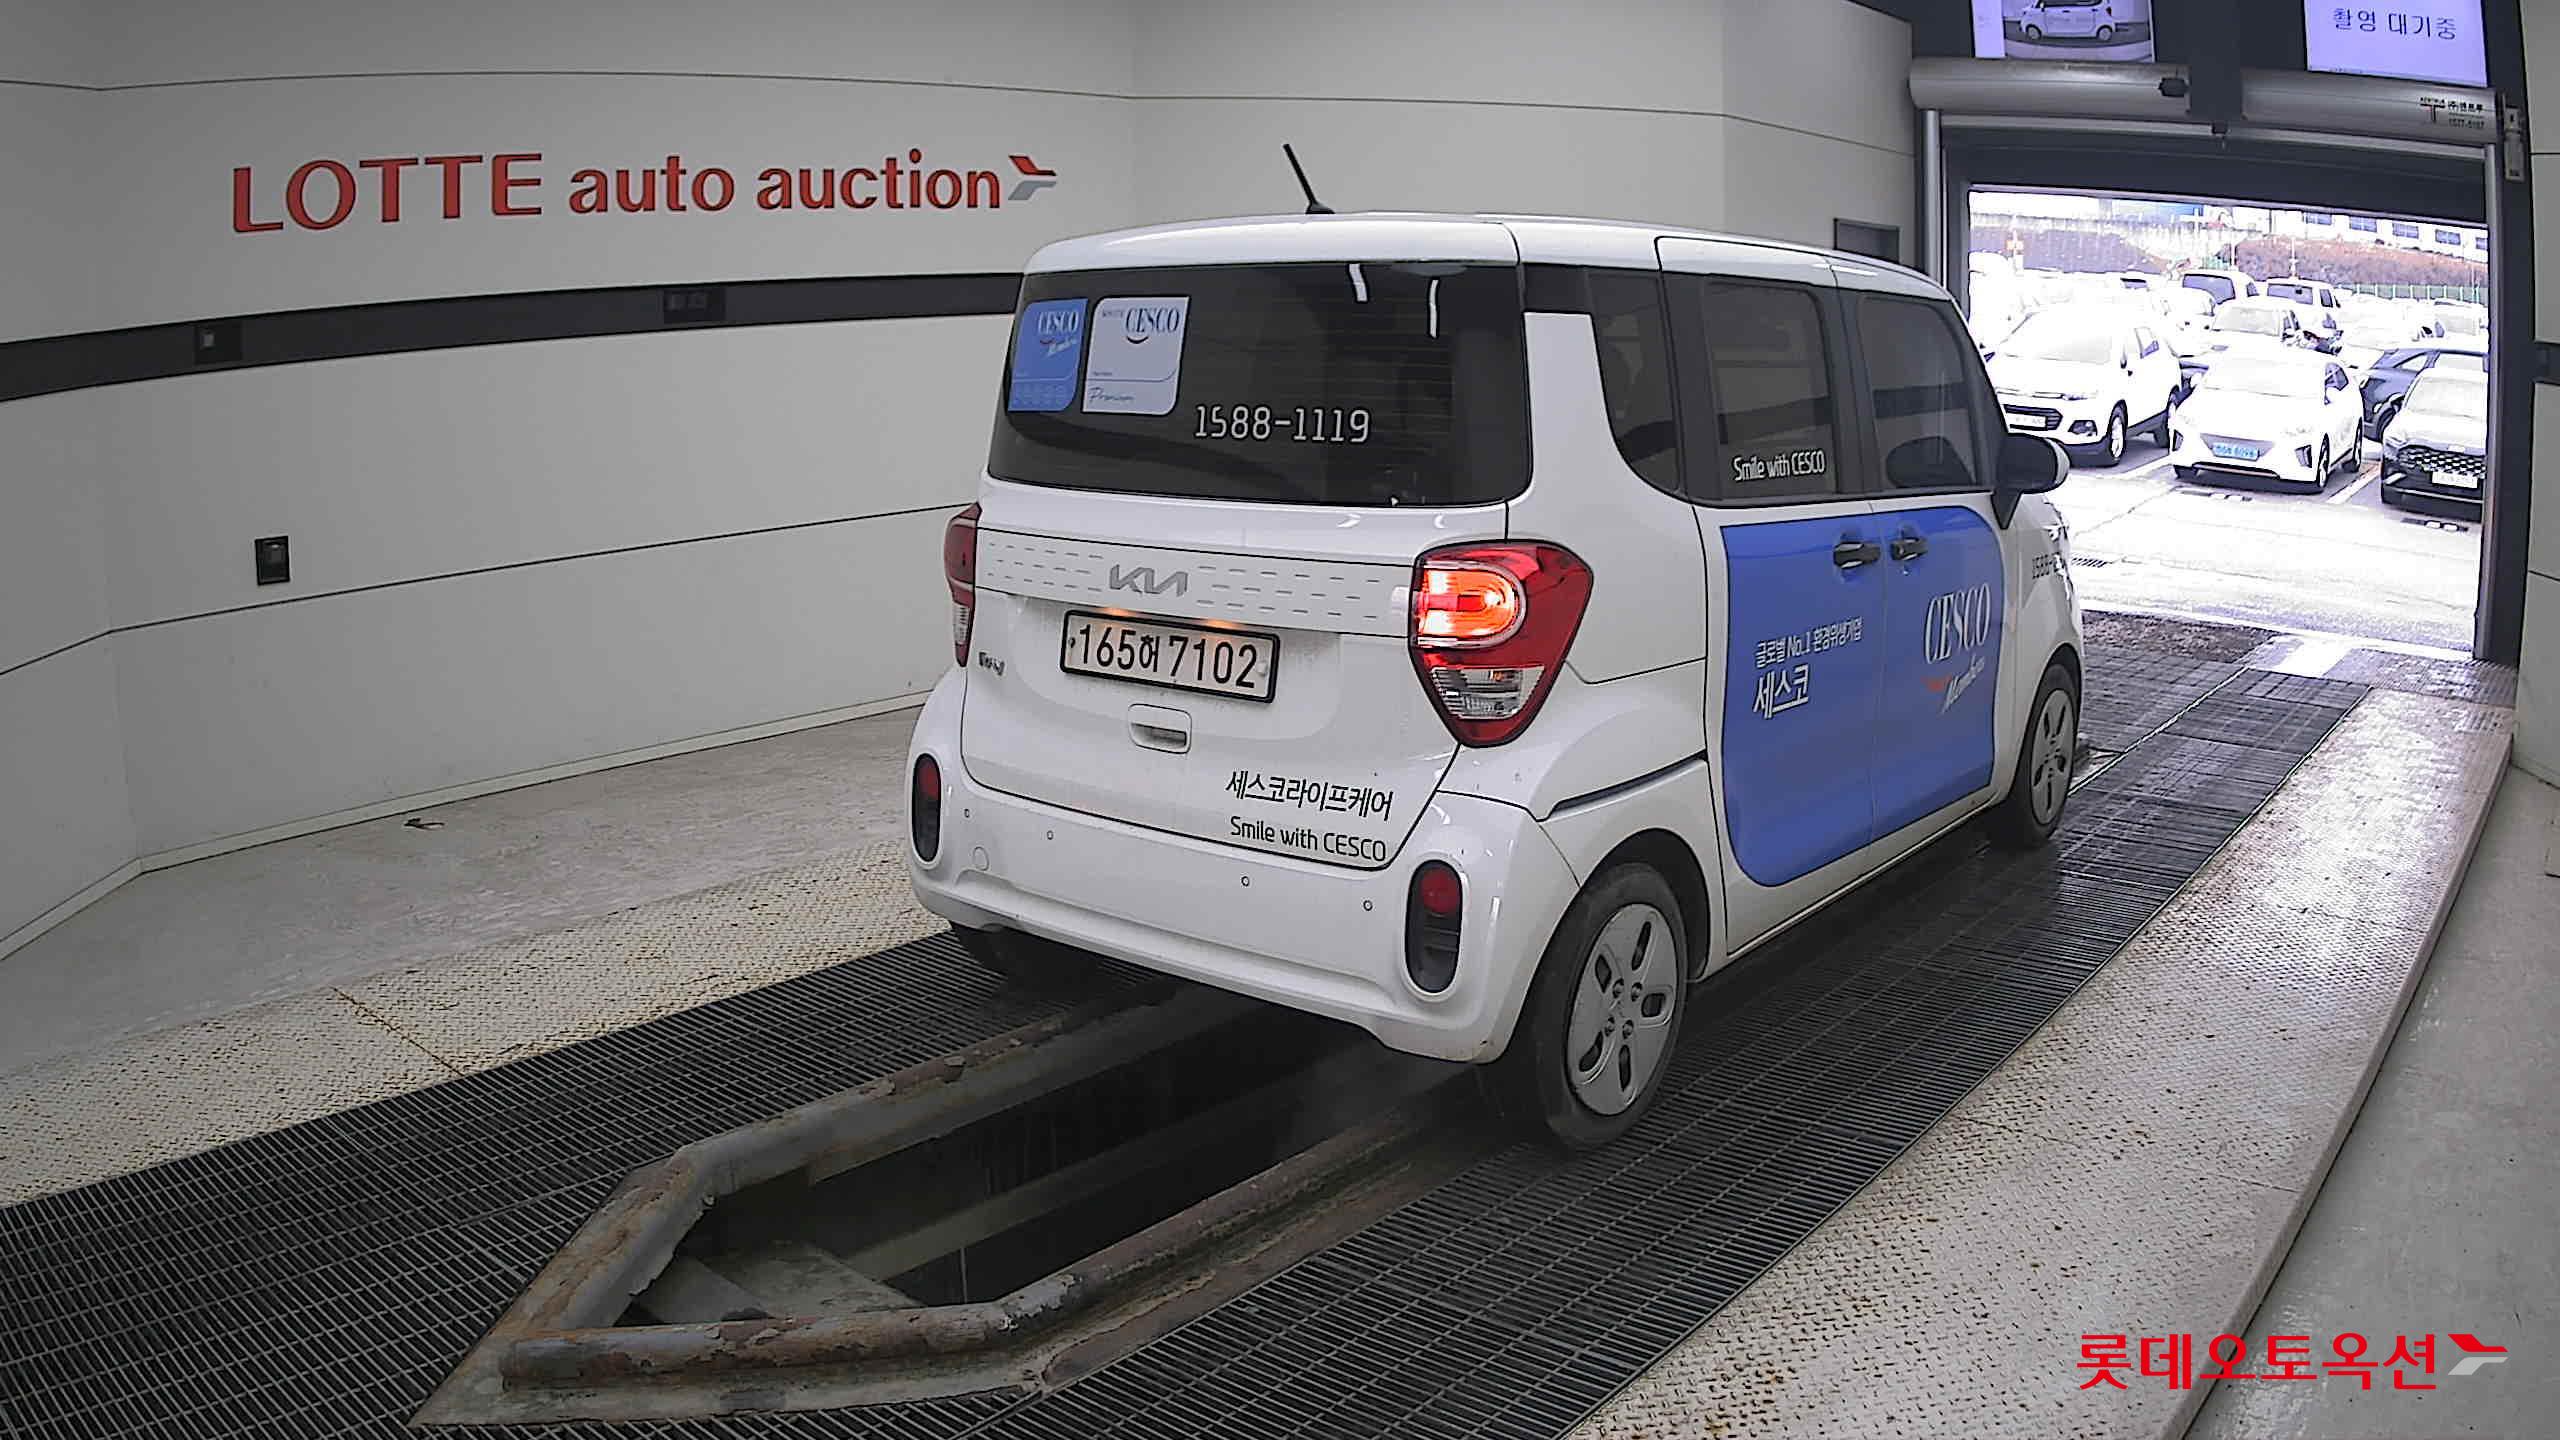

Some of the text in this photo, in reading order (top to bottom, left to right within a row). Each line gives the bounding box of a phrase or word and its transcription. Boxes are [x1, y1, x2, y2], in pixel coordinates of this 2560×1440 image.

[2388, 13, 2457, 40] 대기중
[232, 148, 1000, 233] LOTTE auto auction
[1038, 310, 1079, 336] CESCO
[1126, 306, 1180, 334] CESCO
[1194, 404, 1371, 443] 1588-1119
[1733, 450, 1825, 481] Smile with CESCO
[1925, 583, 1990, 664] CESCO
[1079, 623, 1258, 689] 165허 7102
[1756, 637, 1786, 669] 글로벌
[1753, 663, 1809, 719] 세스코
[1225, 770, 1393, 821] 세스코라이프케어
[1230, 815, 1386, 861] Smile with CESCO
